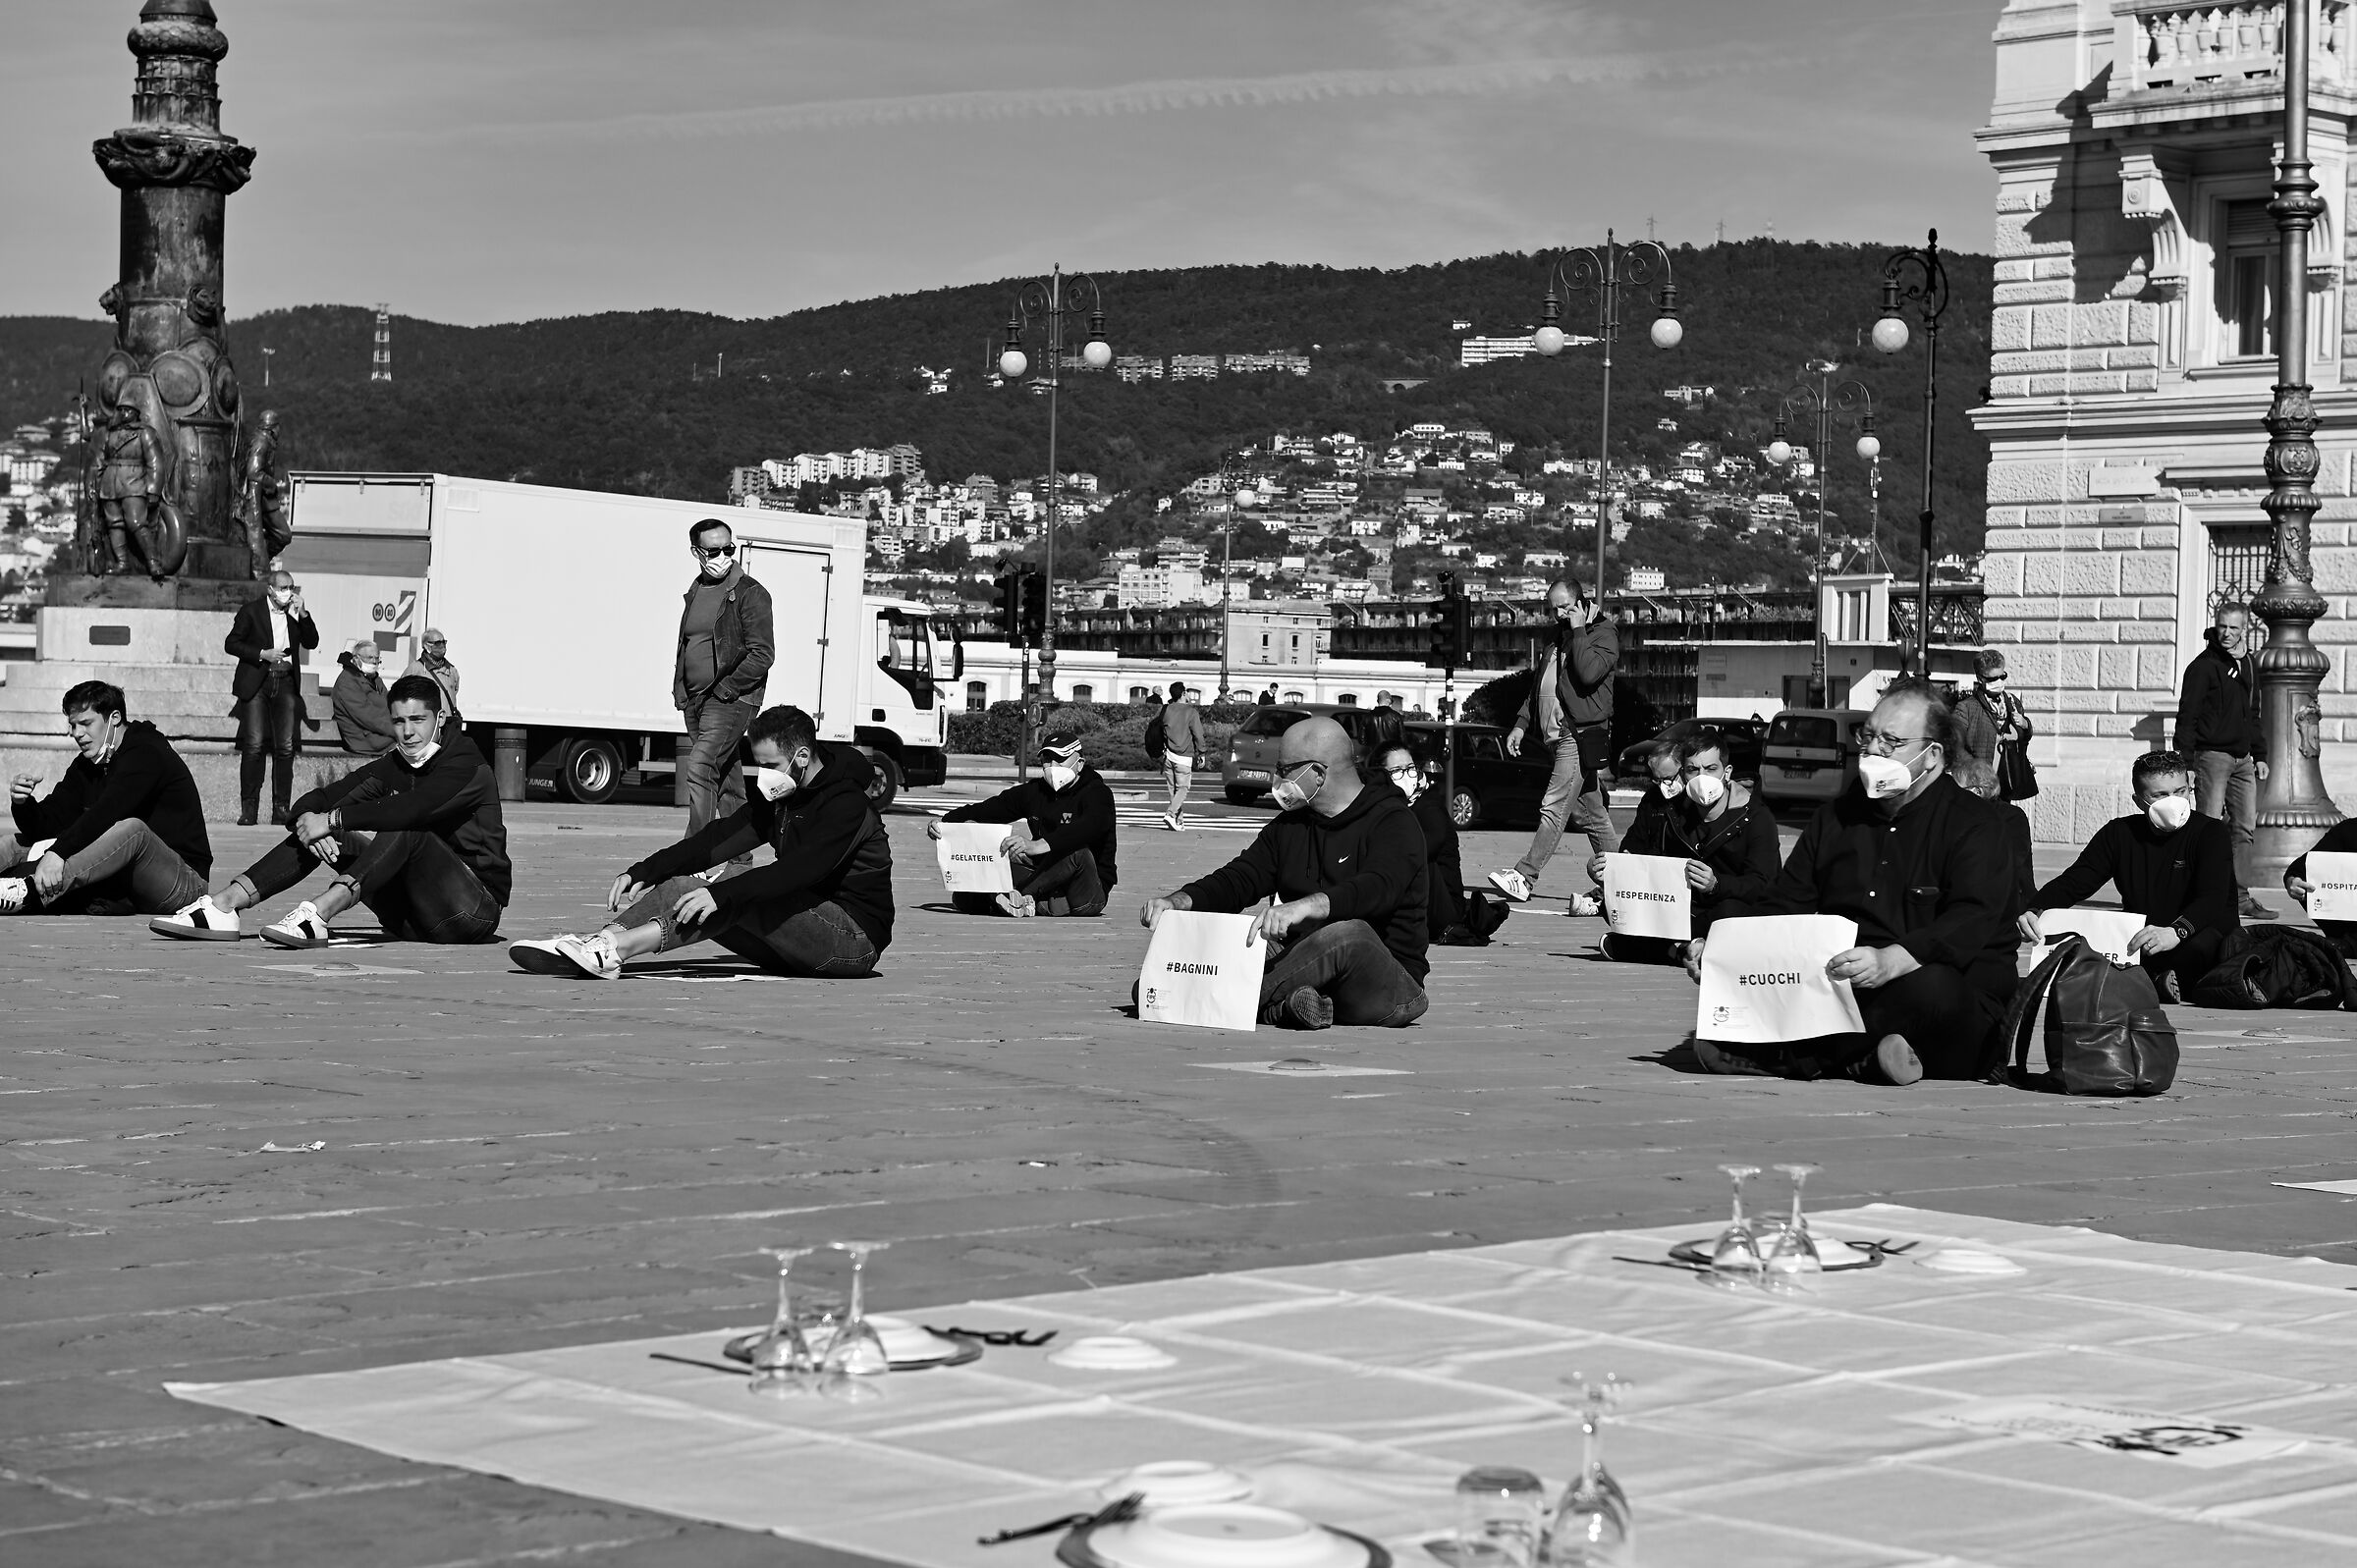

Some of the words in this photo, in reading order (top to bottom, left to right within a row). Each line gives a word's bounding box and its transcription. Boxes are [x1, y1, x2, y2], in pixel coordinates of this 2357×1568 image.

[1616, 891, 1676, 903] #ESPERIENZA
[1166, 961, 1219, 976] #BAGNINI
[1739, 972, 1801, 986] #CUOCHI
